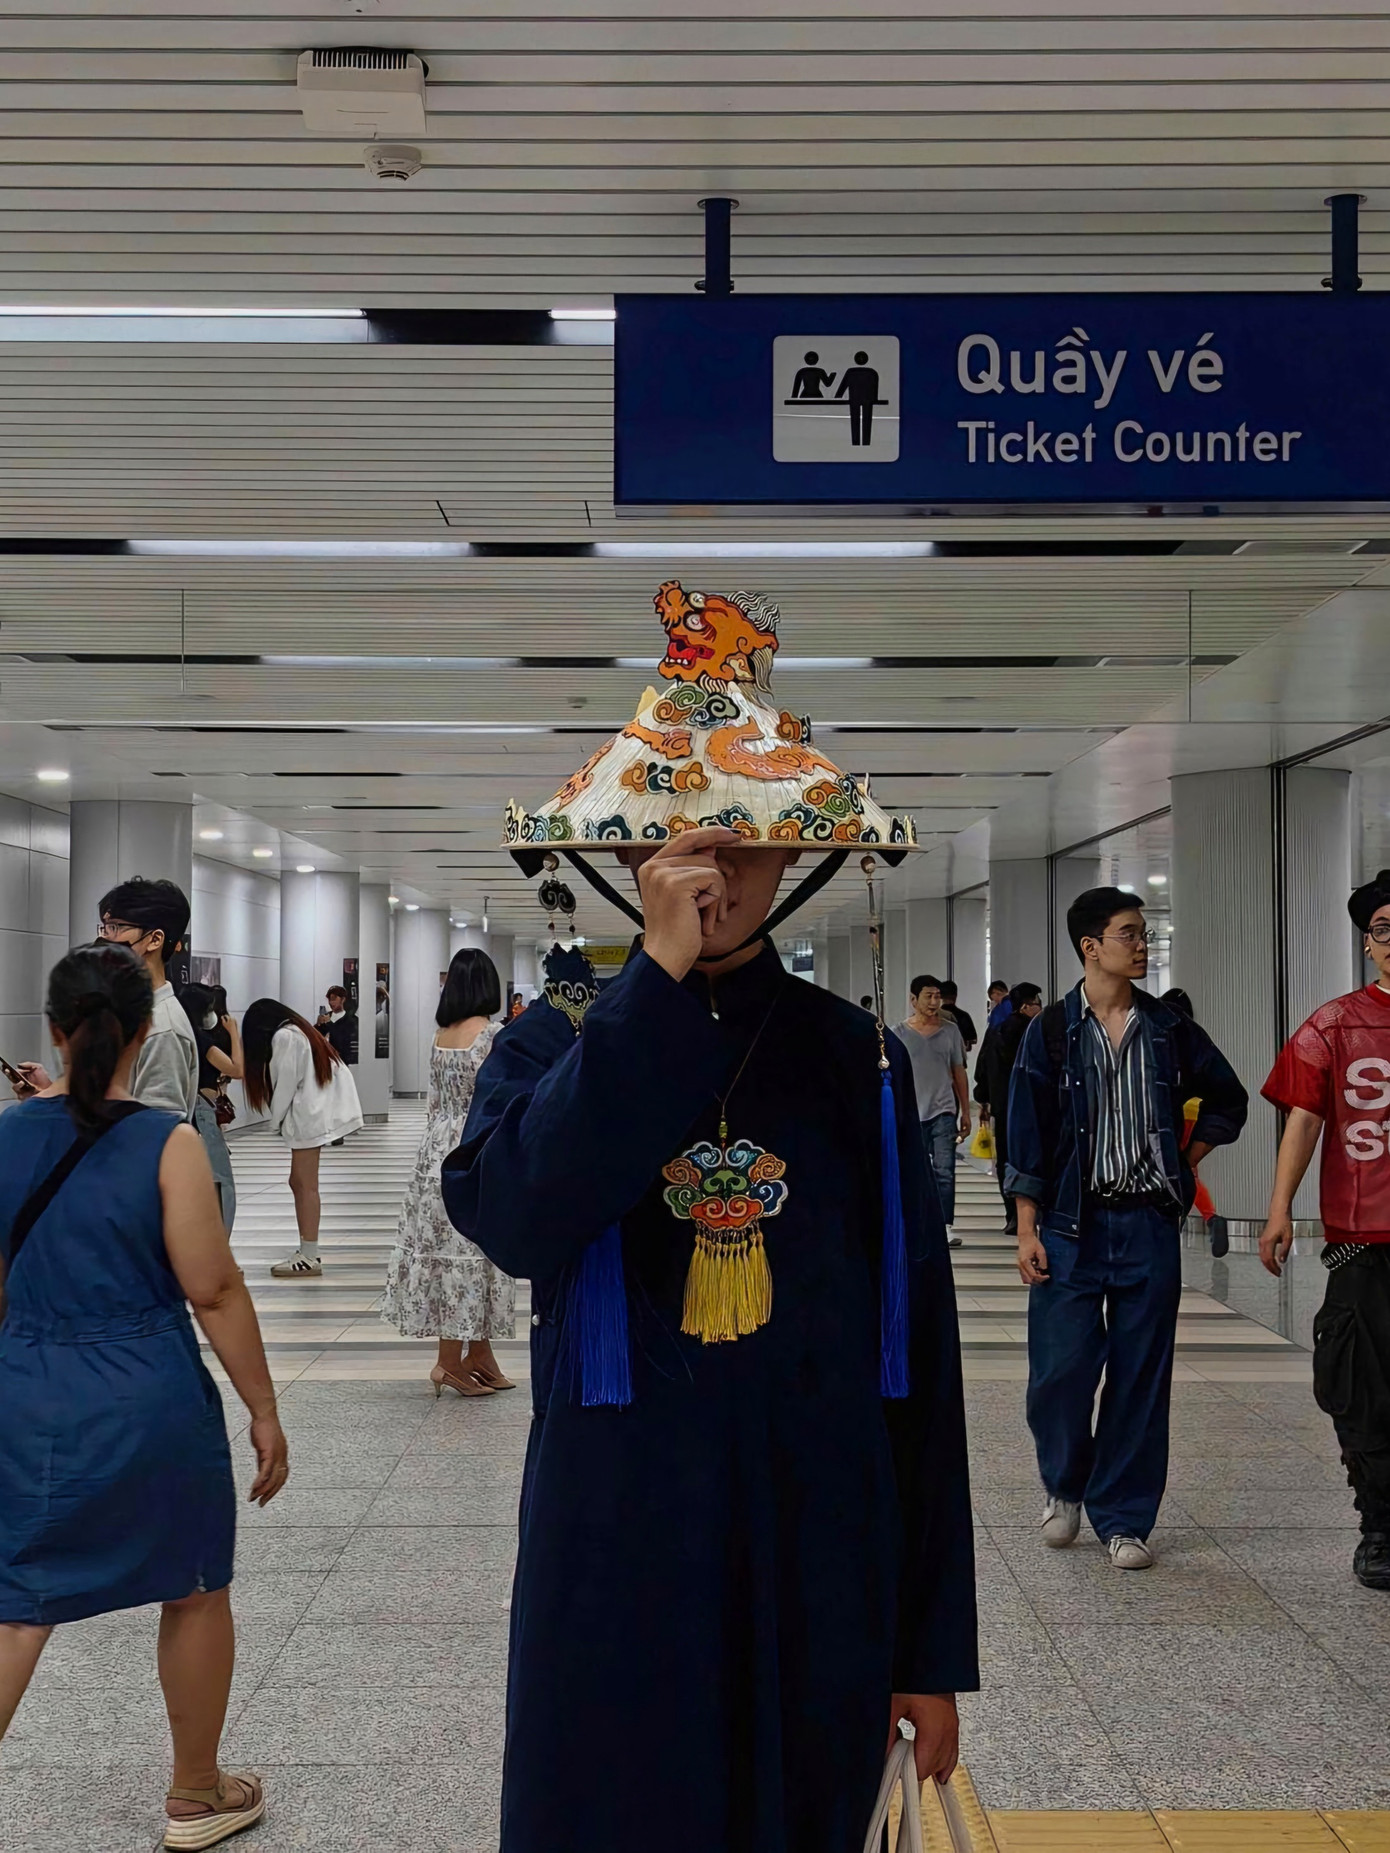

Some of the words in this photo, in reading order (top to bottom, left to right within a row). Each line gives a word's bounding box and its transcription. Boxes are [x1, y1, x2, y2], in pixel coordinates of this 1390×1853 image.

[957, 327, 1127, 409] Quầy
[1148, 333, 1223, 393] vé
[957, 421, 1097, 463] Ticket
[1114, 420, 1302, 462] Counter
